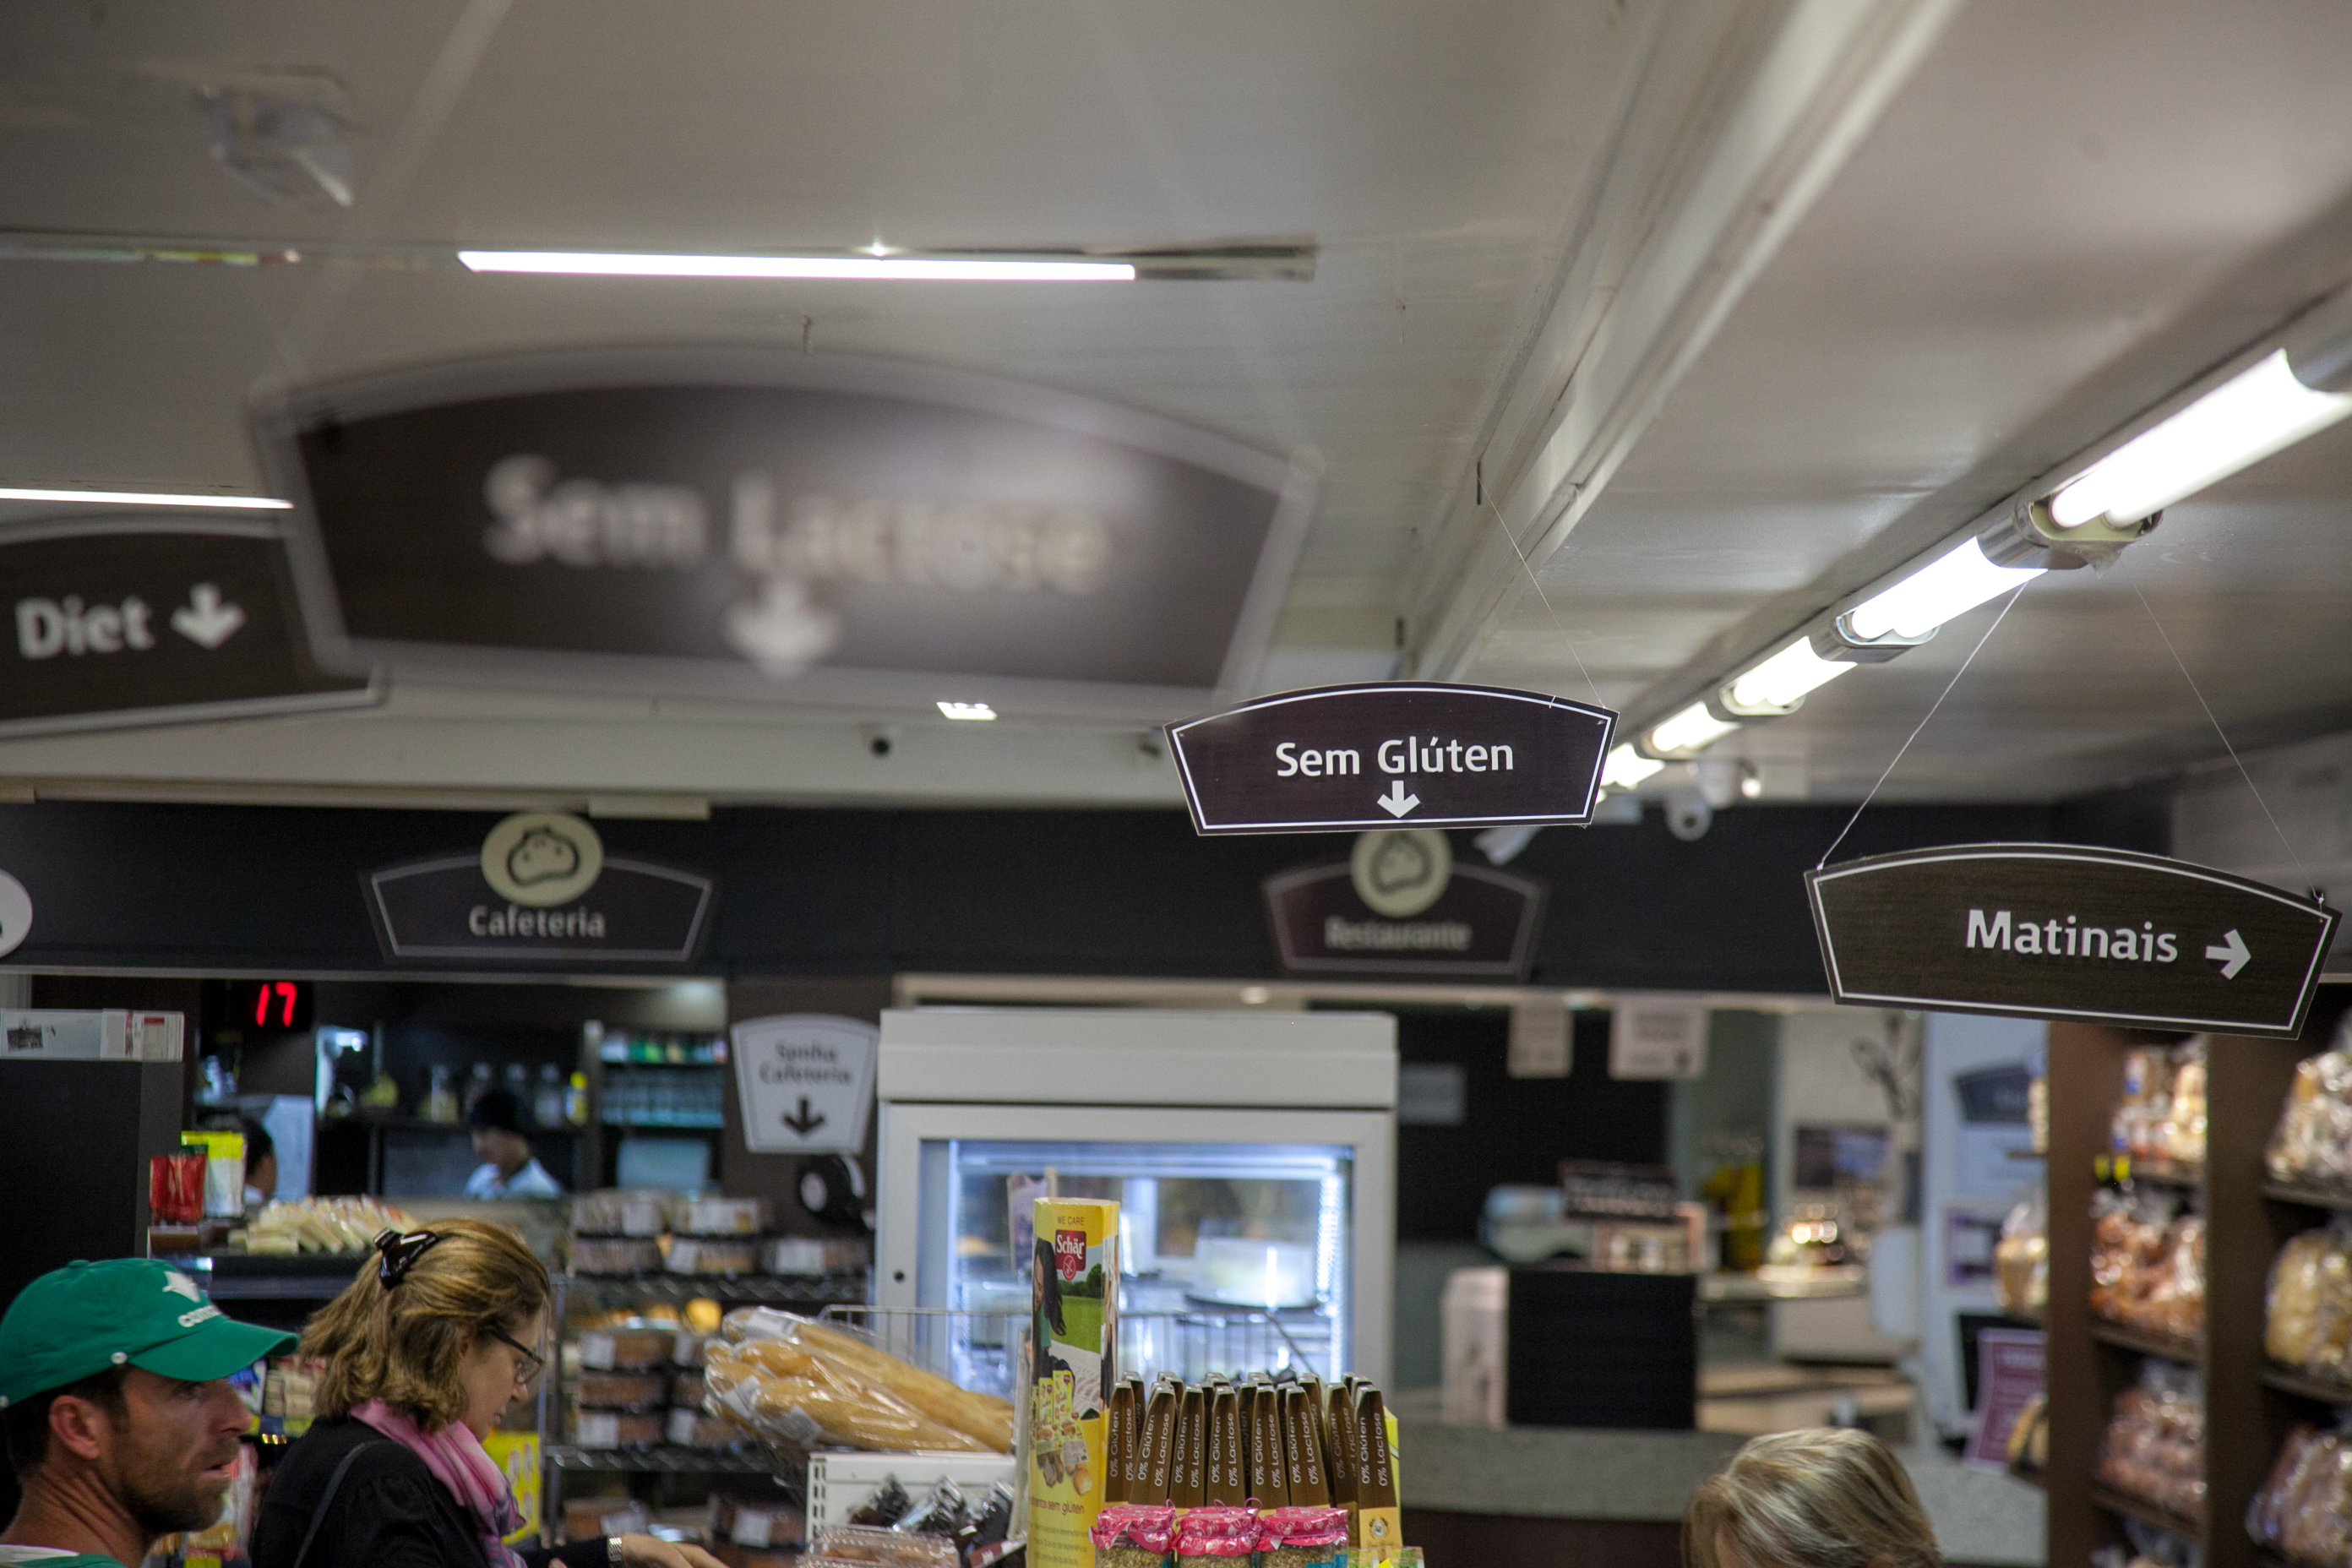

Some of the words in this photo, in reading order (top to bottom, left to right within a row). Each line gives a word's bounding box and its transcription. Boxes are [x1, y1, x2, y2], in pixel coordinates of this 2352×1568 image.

[14, 595, 155, 660] Diet
[1276, 743, 1360, 776] Sem
[1377, 736, 1514, 774] Glúten
[469, 904, 606, 938] Cafeteria
[1966, 908, 2178, 963] Matinais
[256, 982, 297, 1026] 17
[1067, 1217, 1085, 1226] CARE
[1056, 1234, 1085, 1260] Schär
[1111, 1411, 1119, 1455] Glúten
[1142, 1414, 1155, 1458] Glúten
[1157, 1413, 1170, 1465] Lactose
[1177, 1416, 1188, 1462] Glúten
[1192, 1413, 1200, 1466] Lactose
[1212, 1416, 1221, 1462] Glúten
[1228, 1413, 1237, 1465] Lactose
[1269, 1414, 1279, 1466] Lactose
[1289, 1416, 1298, 1461] Glúten
[1301, 1412, 1315, 1462] Lactose
[1359, 1417, 1369, 1462] Glúten
[1374, 1413, 1386, 1464] Lactose
[1109, 1458, 1119, 1478] 0%
[1125, 1462, 1134, 1481] 0%
[1138, 1462, 1149, 1480] 0%
[1154, 1467, 1164, 1487] 0%
[1174, 1464, 1184, 1484] 0%
[1190, 1468, 1199, 1488] 0%
[1211, 1464, 1220, 1484] 0%
[1228, 1467, 1238, 1487] 0%
[1255, 1466, 1264, 1485] 0%
[1271, 1468, 1281, 1489] 0%
[1292, 1463, 1301, 1484] 0%
[1308, 1465, 1319, 1485] 0%
[1361, 1465, 1370, 1484] 0%
[1379, 1467, 1388, 1487] 0%
